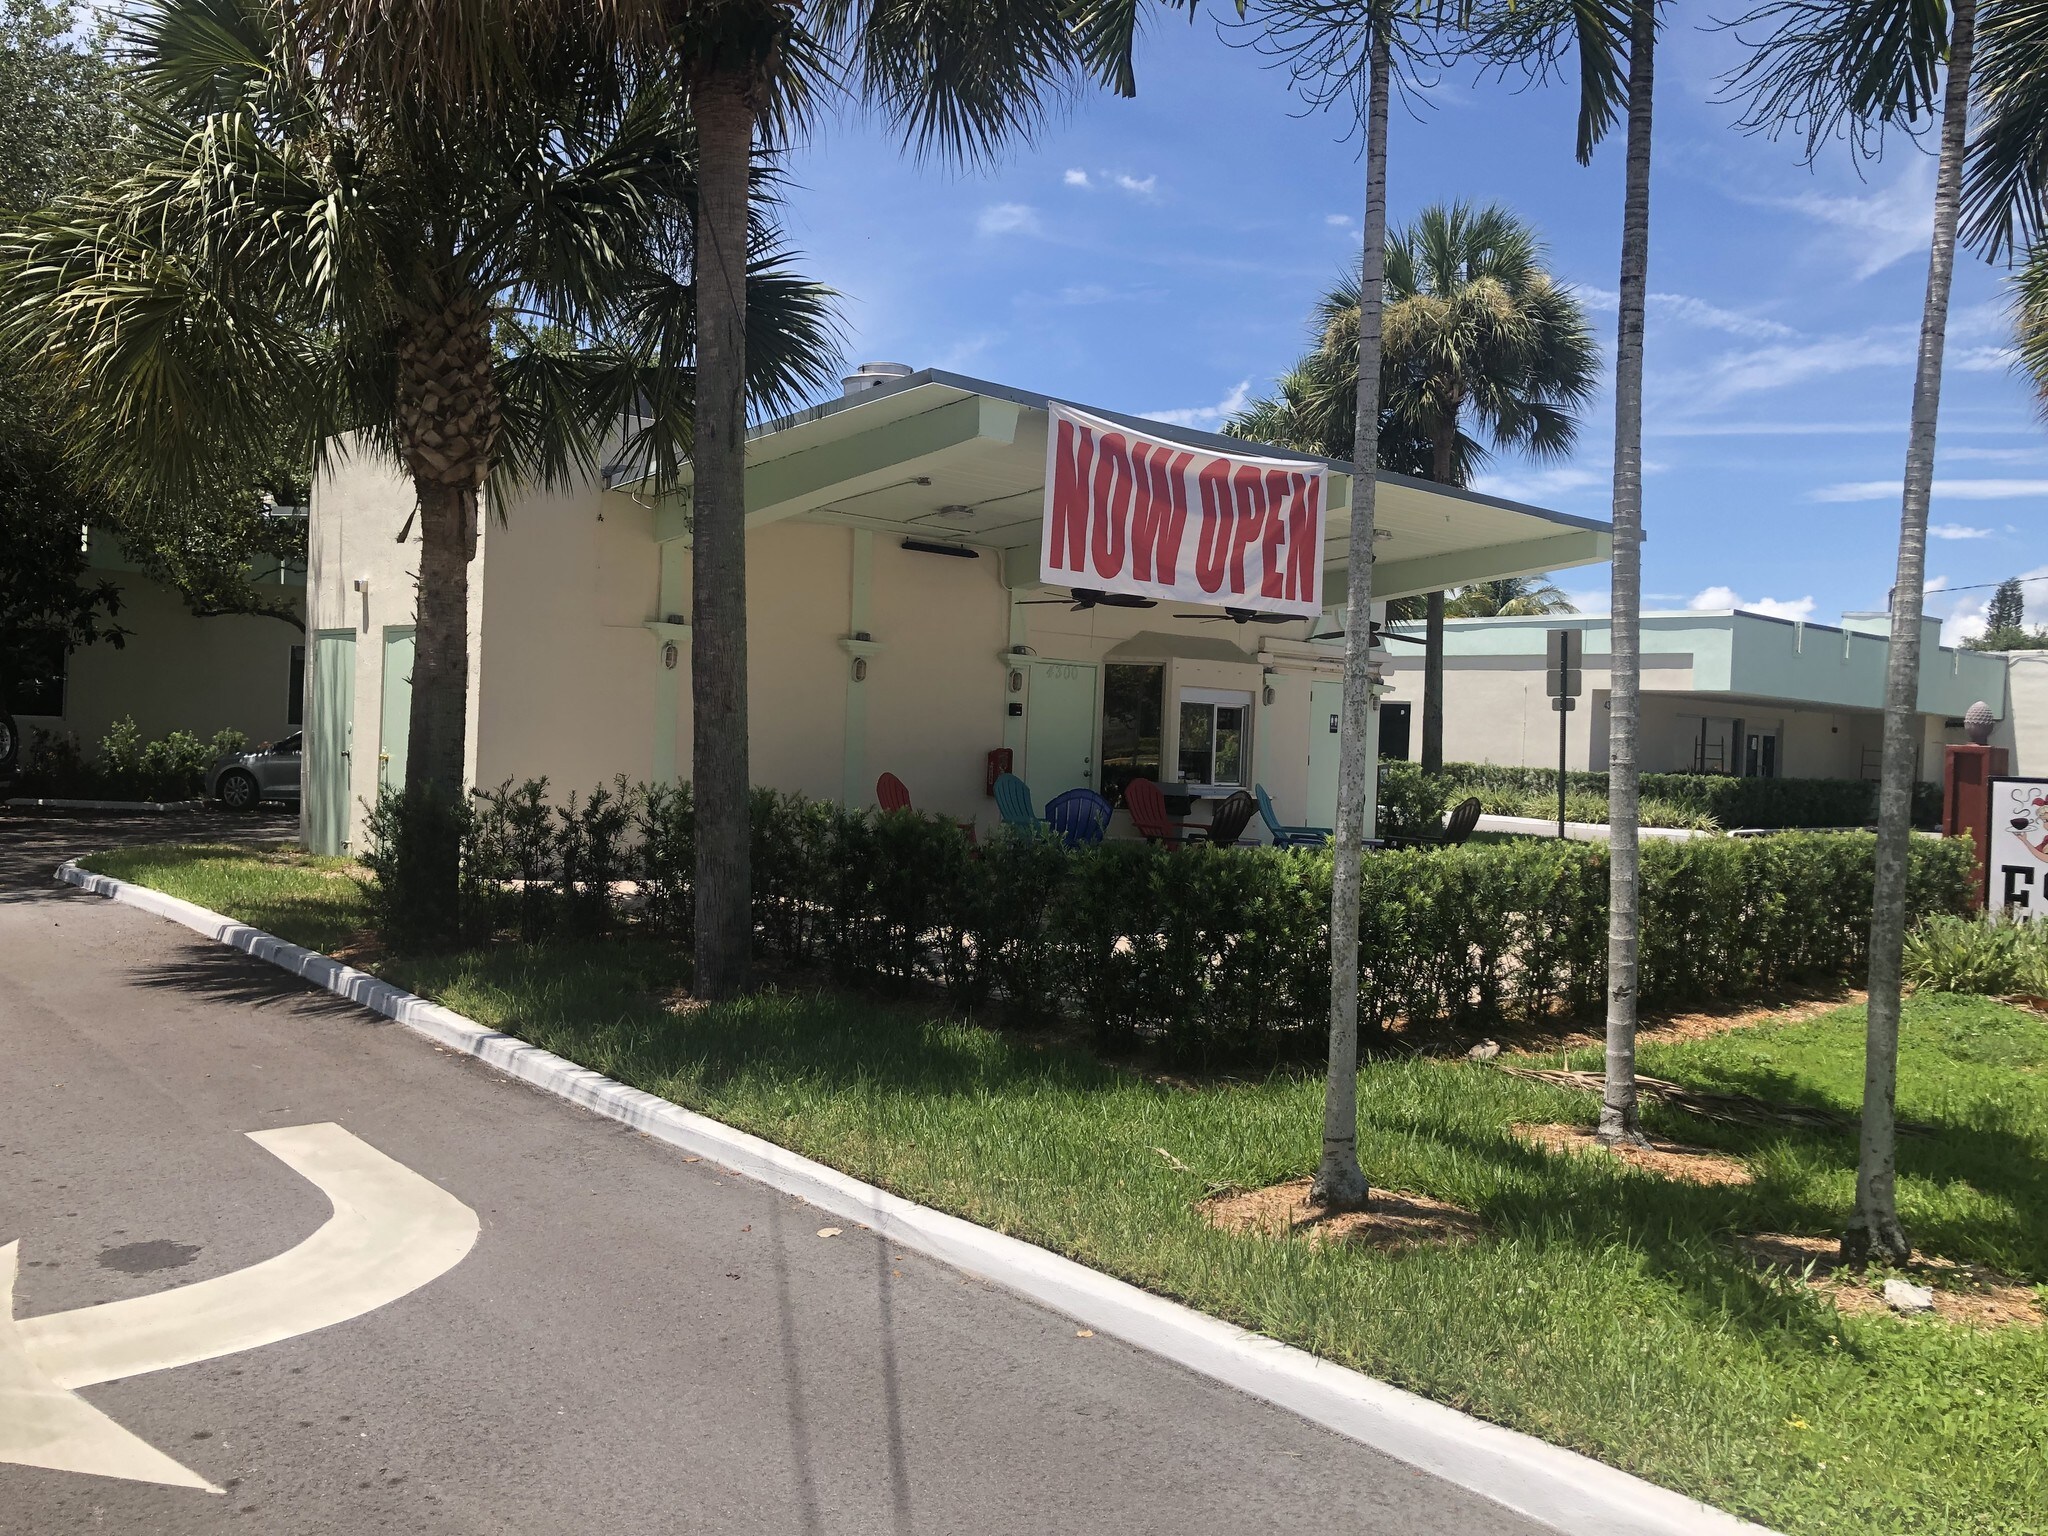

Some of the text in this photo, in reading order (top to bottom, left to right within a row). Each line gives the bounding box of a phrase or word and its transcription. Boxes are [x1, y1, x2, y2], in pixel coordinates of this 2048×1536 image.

[1050, 419, 1320, 603] NOW OPEN
[1046, 665, 1078, 680] 4300
[2001, 865, 2048, 924] E
